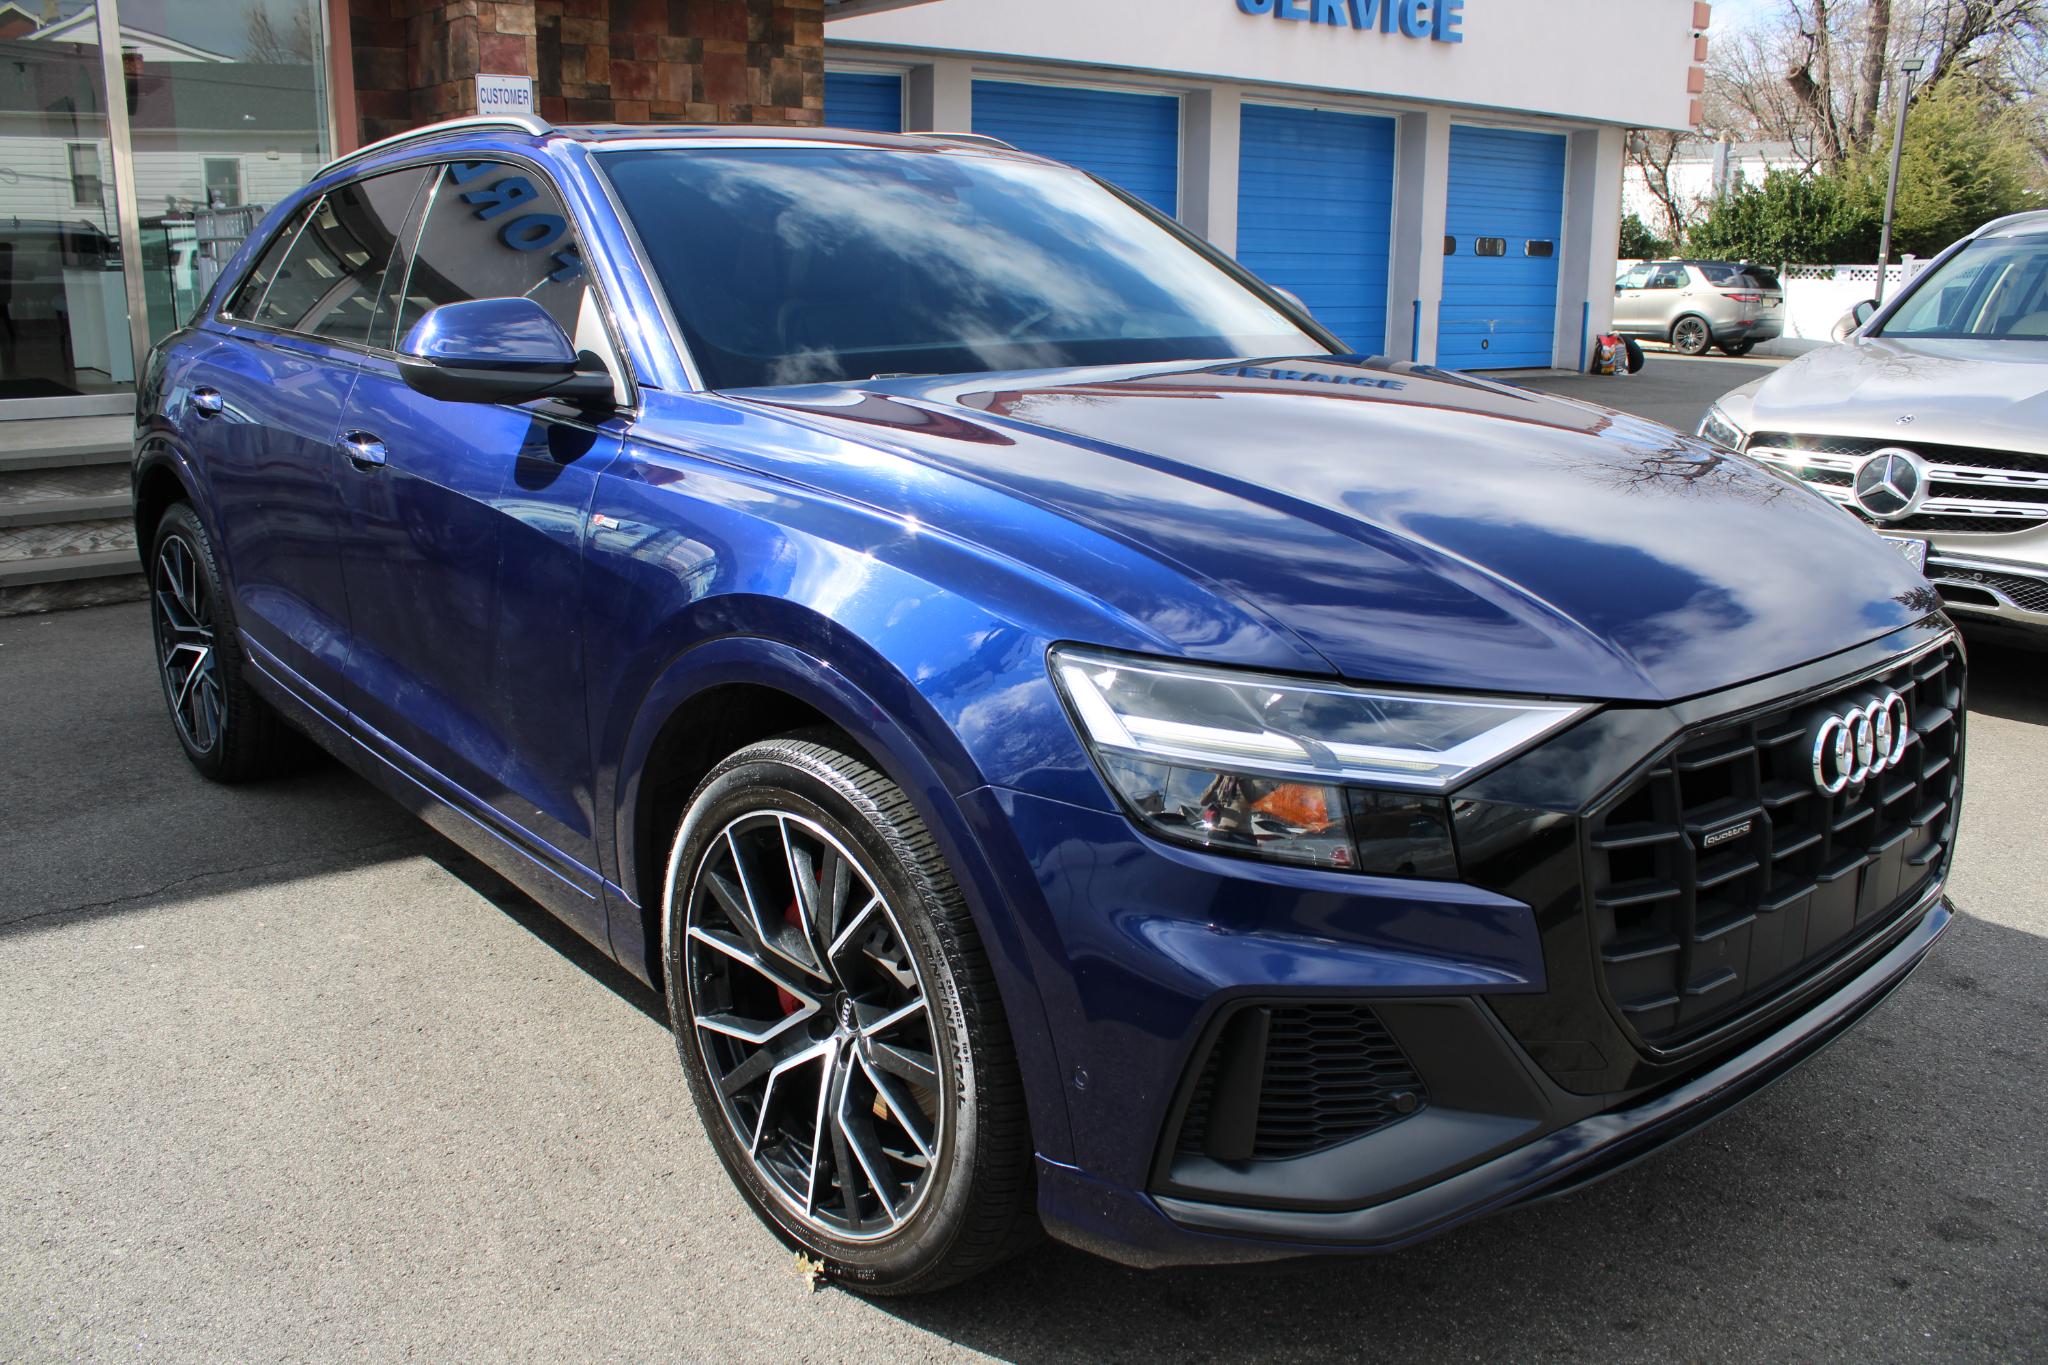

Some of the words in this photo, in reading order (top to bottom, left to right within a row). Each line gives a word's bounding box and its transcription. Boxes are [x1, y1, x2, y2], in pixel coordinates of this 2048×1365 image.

[480, 87, 529, 105] CUSTOMER
[1706, 824, 1750, 844] quattro
[914, 924, 966, 1110] CONTINENTAL
